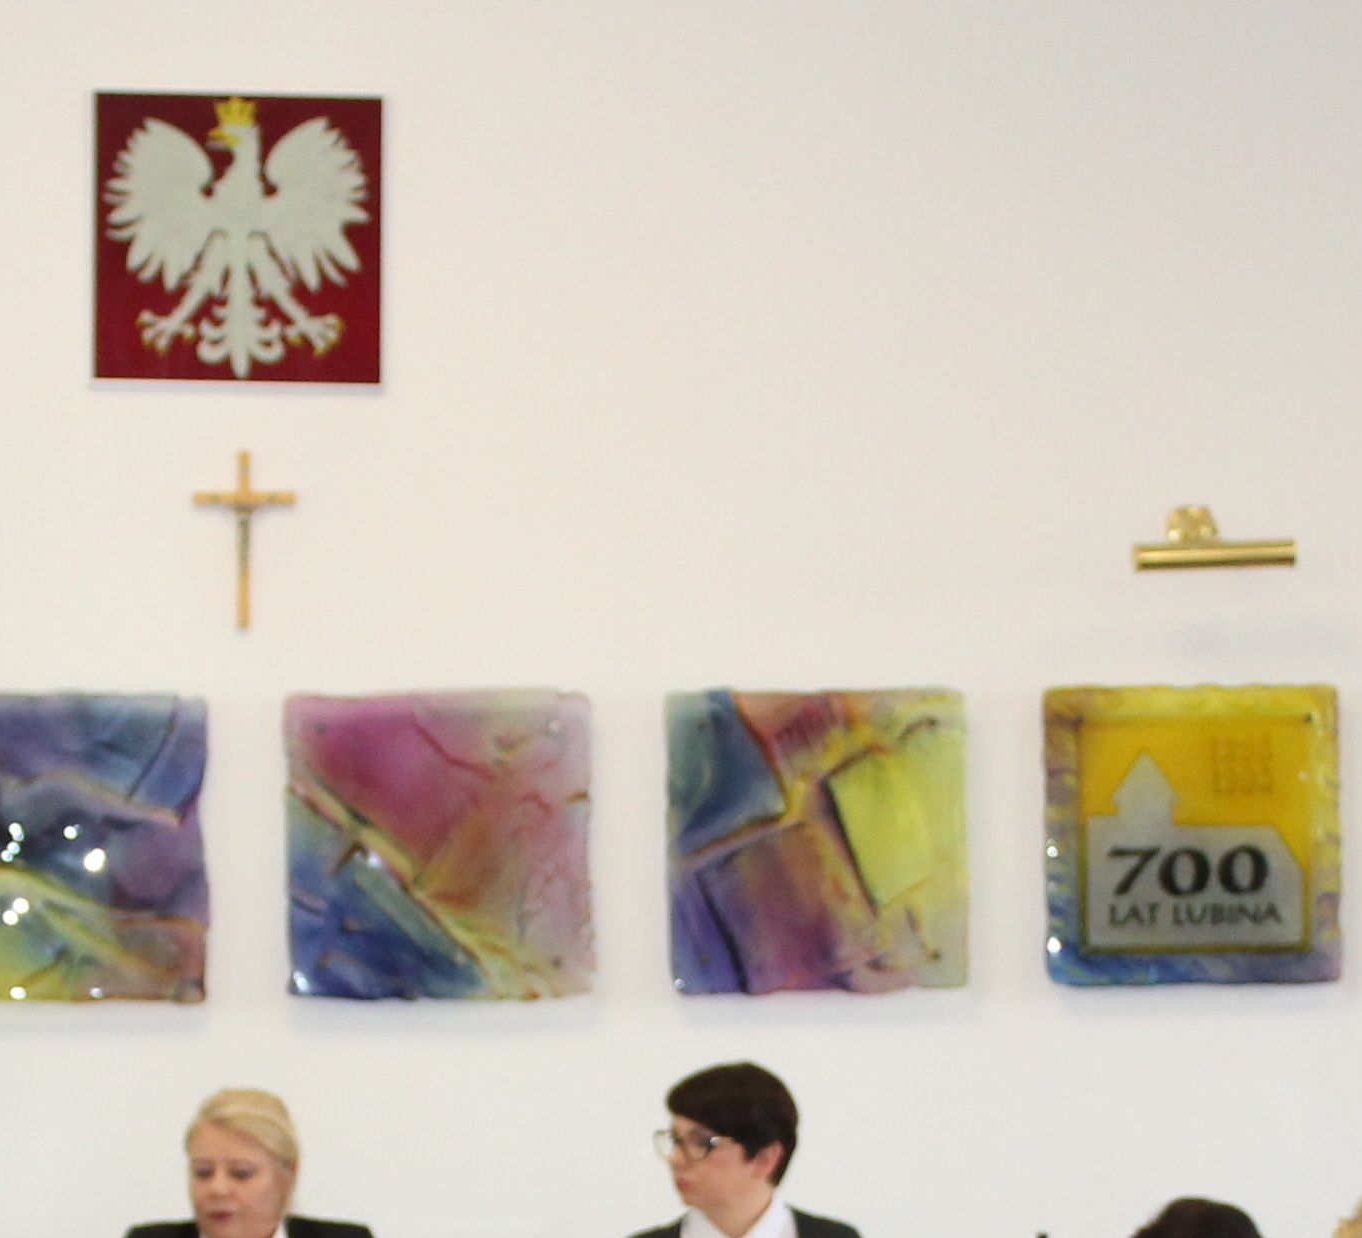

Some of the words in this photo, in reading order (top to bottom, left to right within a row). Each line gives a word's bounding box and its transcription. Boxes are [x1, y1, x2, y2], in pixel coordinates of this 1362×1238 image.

[1107, 845, 1269, 896] 700
[1109, 901, 1159, 927] LAT
[1172, 901, 1283, 926] LUBINA
